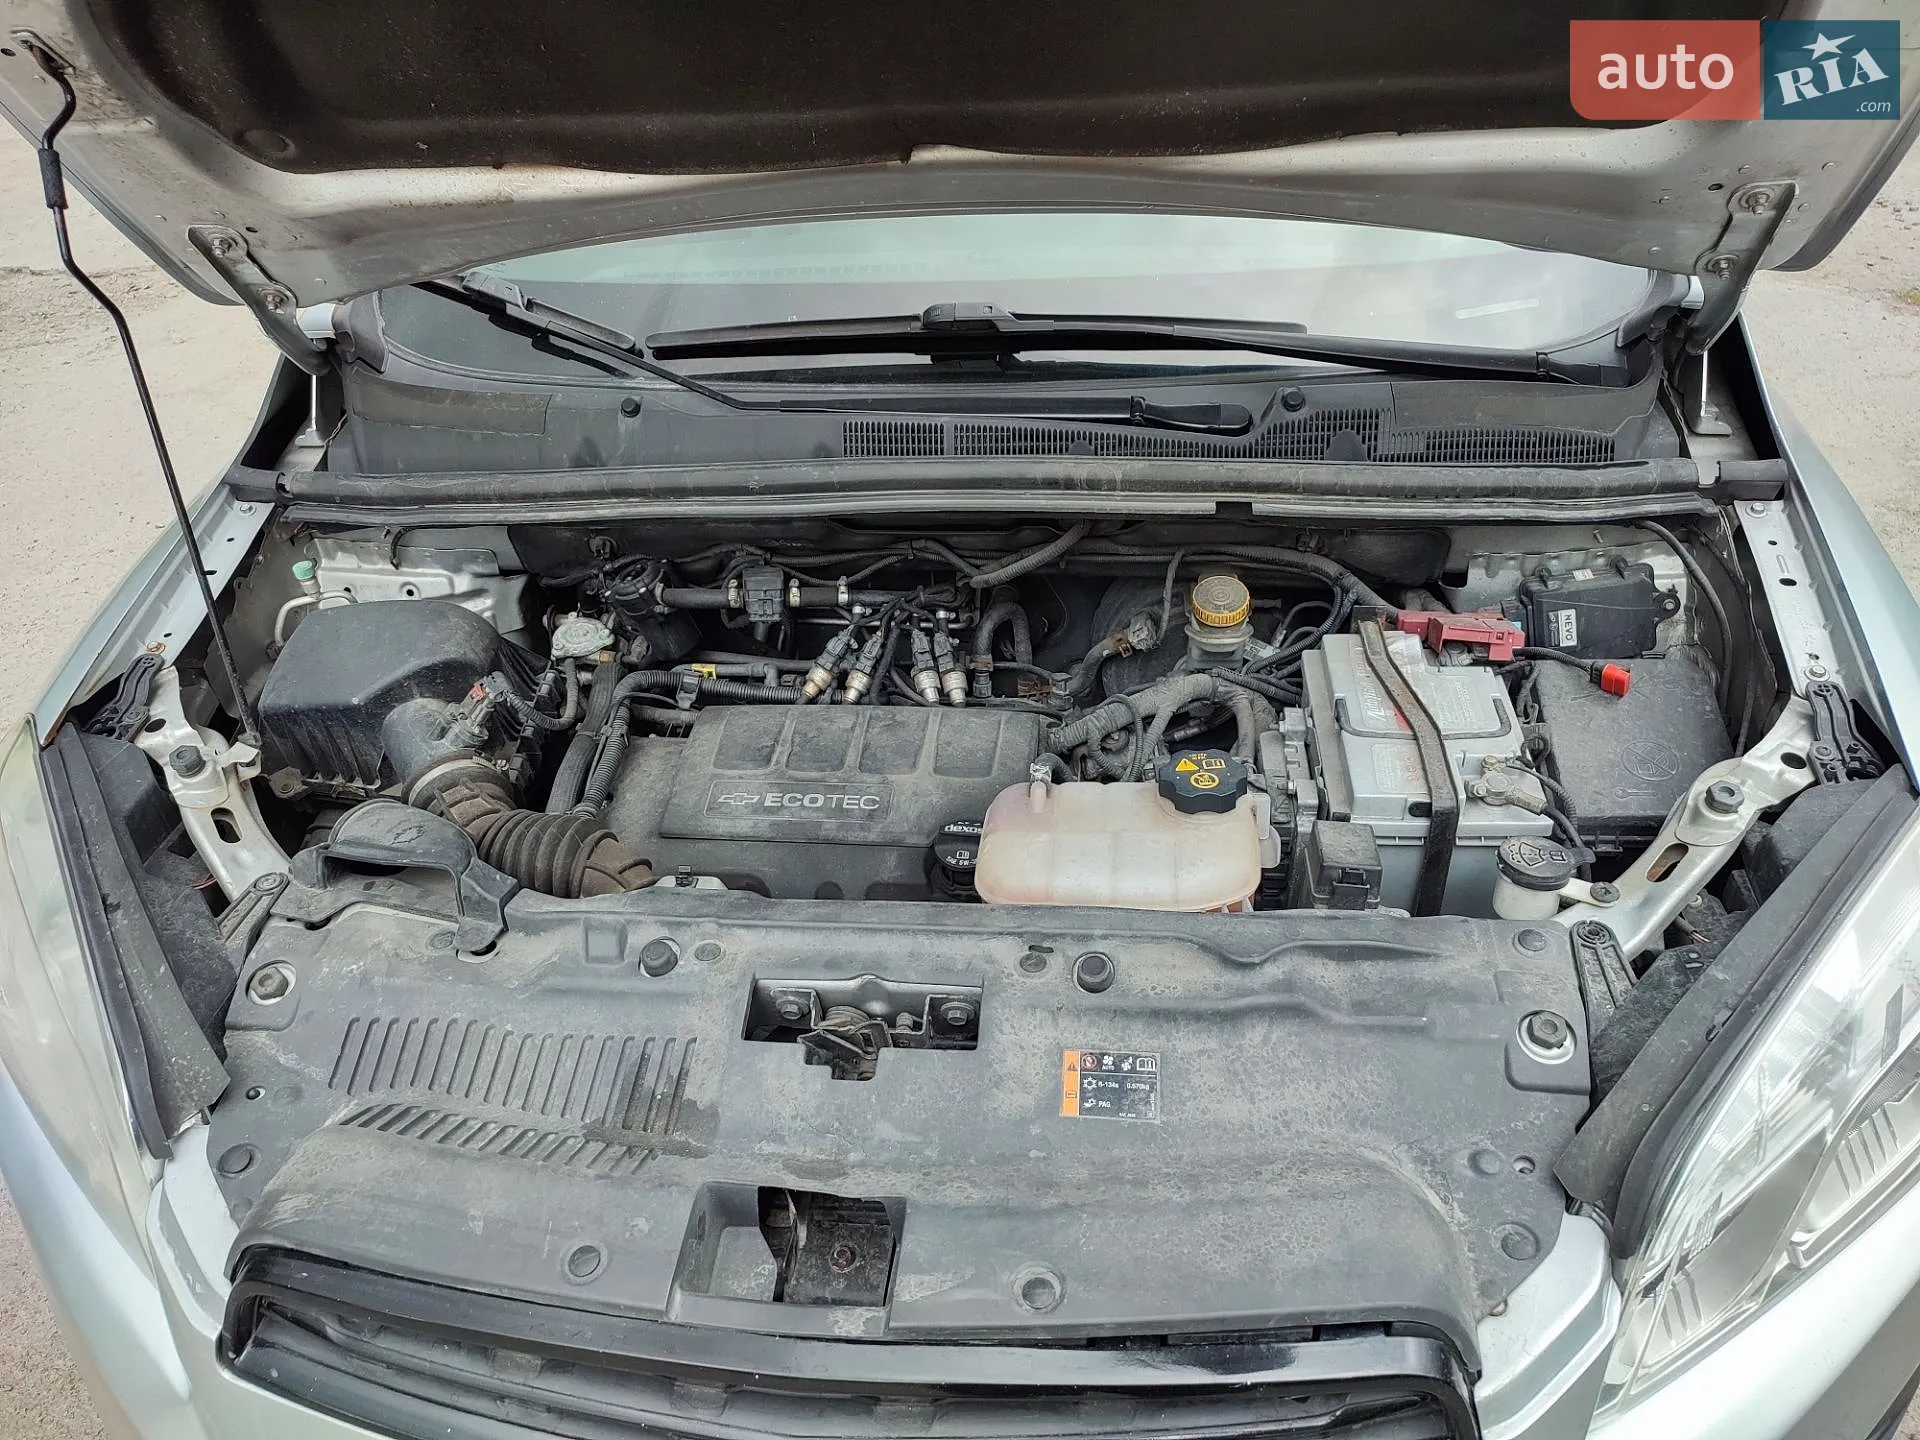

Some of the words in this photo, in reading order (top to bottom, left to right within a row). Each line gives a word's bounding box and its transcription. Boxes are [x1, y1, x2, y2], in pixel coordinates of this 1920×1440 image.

[1564, 614, 1574, 641] NEVO
[764, 793, 880, 810] ECOTEC
[1098, 1100, 1111, 1108] PAG
